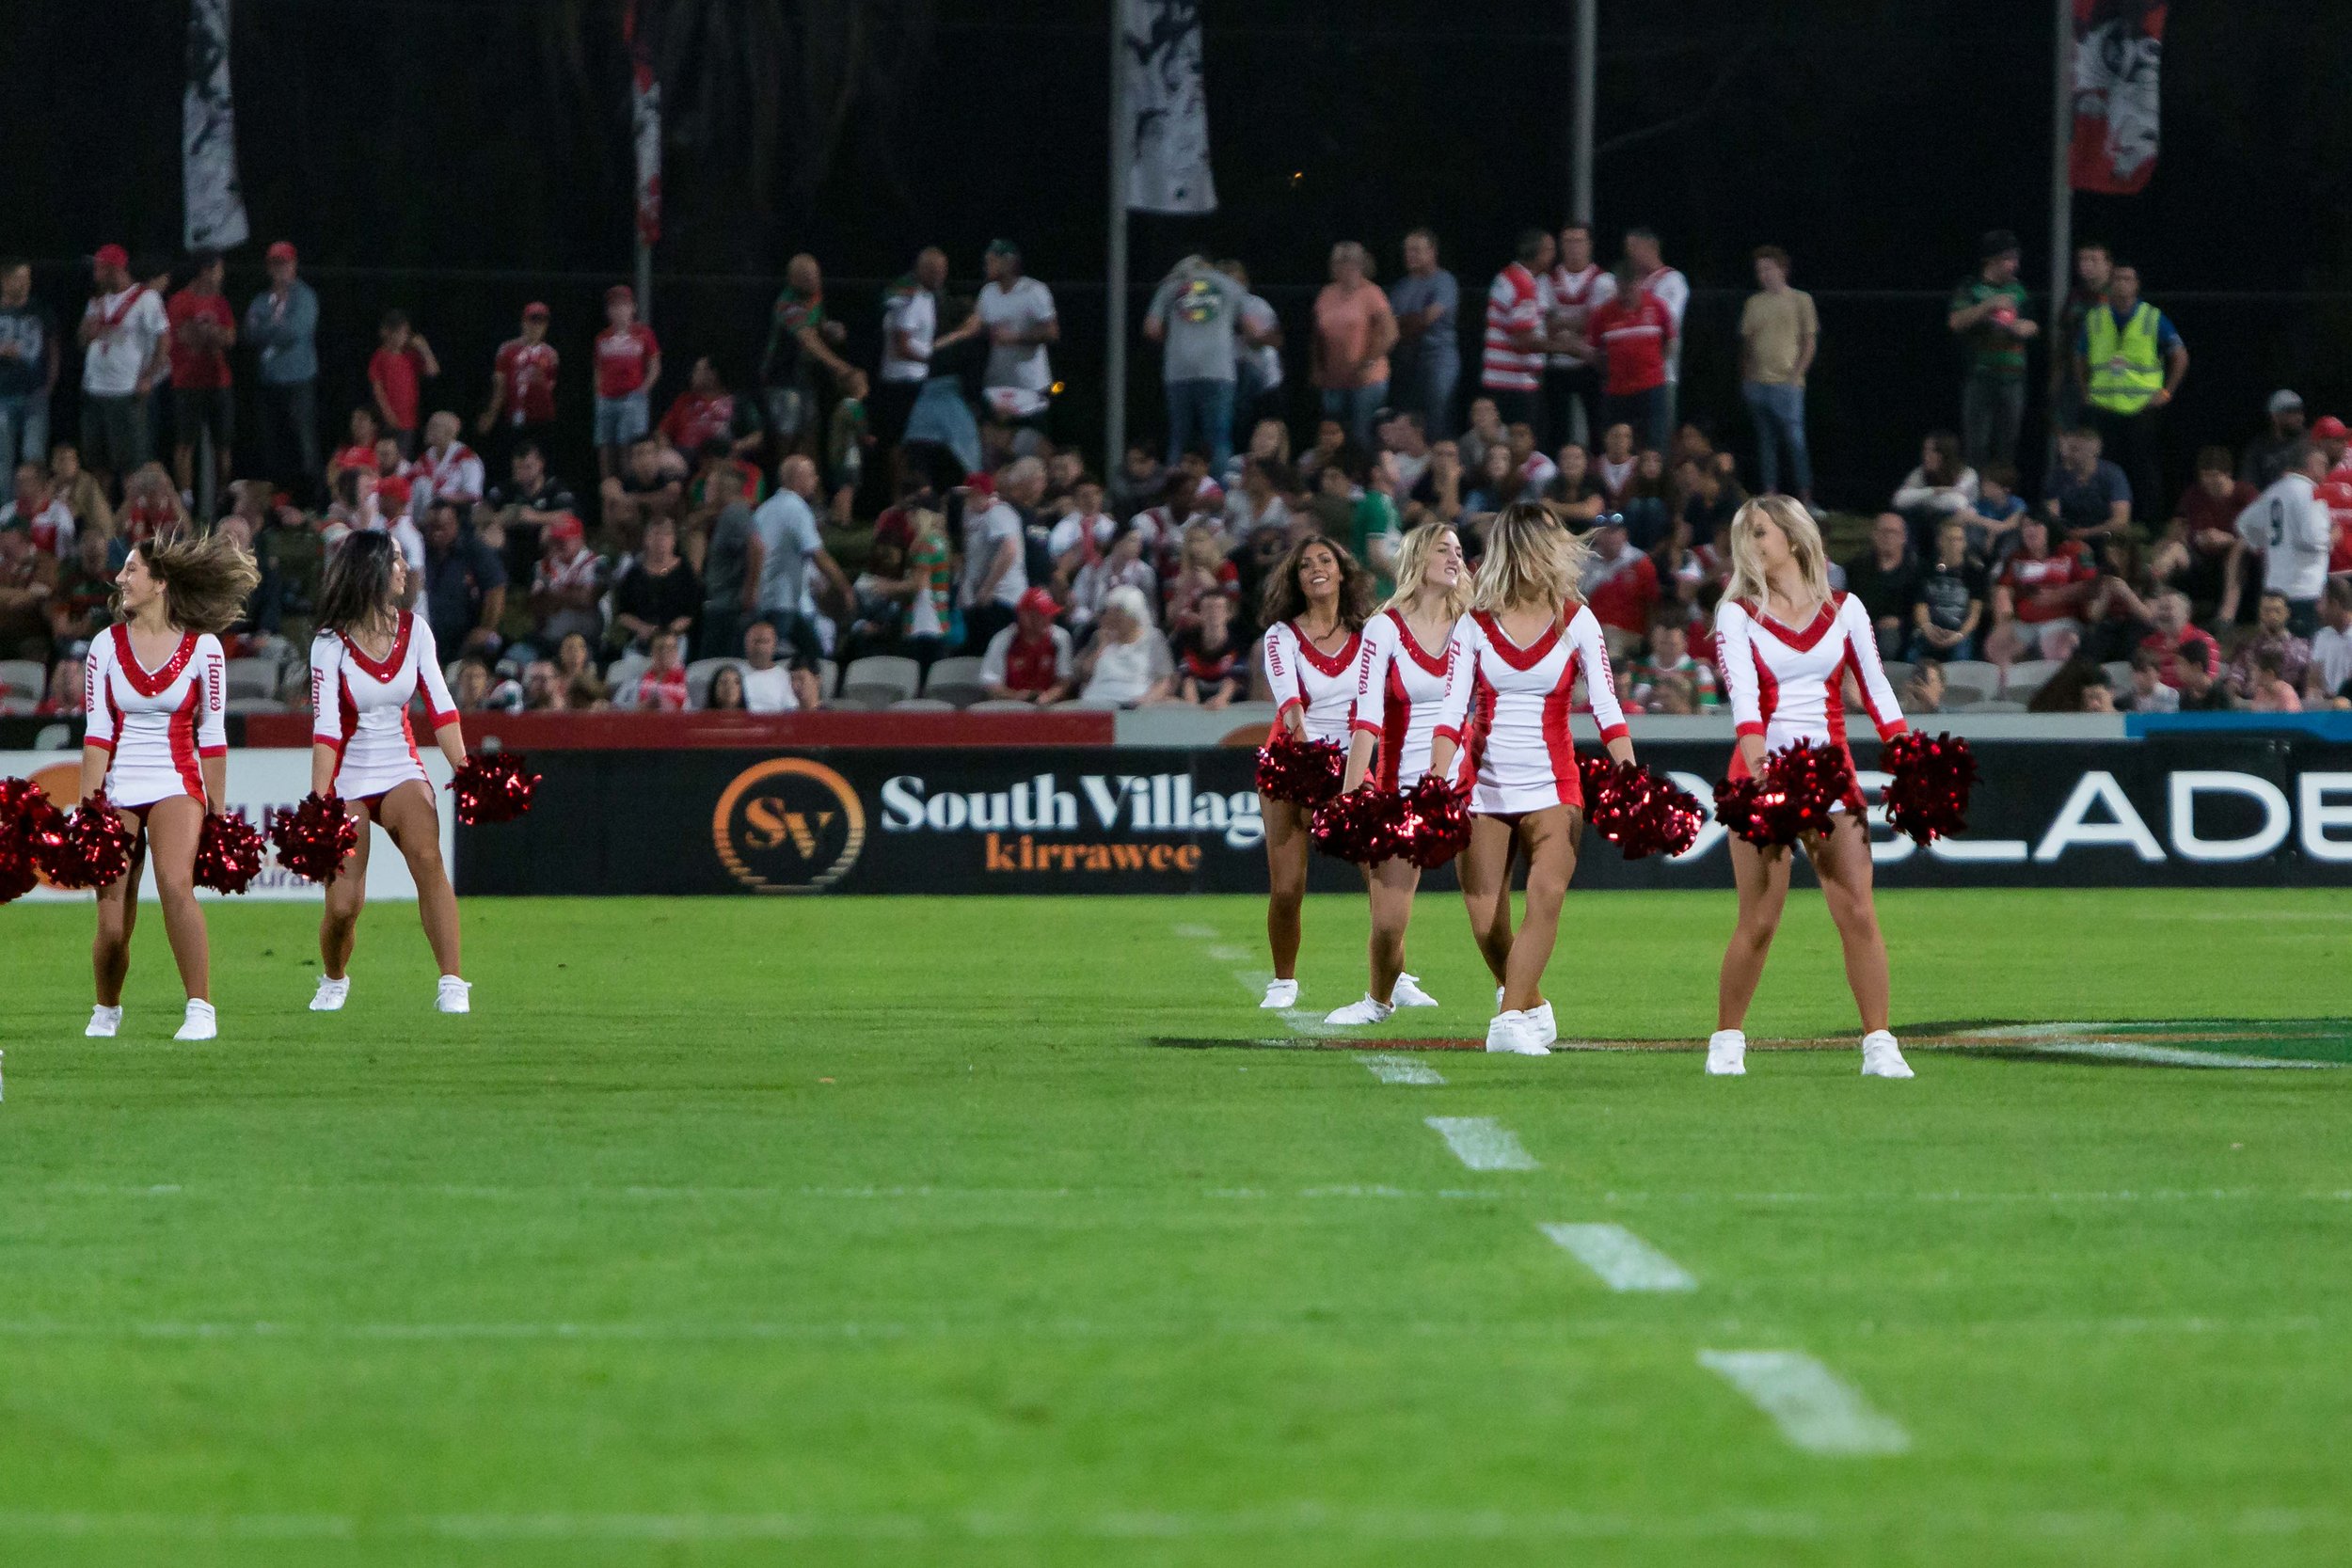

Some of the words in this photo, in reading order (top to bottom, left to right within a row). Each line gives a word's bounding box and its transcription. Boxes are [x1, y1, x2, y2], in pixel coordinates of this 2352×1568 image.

[2270, 497, 2284, 546] 9
[86, 653, 98, 713] Flames
[206, 653, 224, 712] Flames
[1266, 634, 1285, 677] Flames
[1358, 638, 1377, 696] Flames
[311, 666, 326, 720] Flames
[745, 798, 835, 860] SV
[880, 773, 1078, 832] South
[1080, 773, 1266, 848] Villag
[986, 832, 1202, 872] kirrawee
